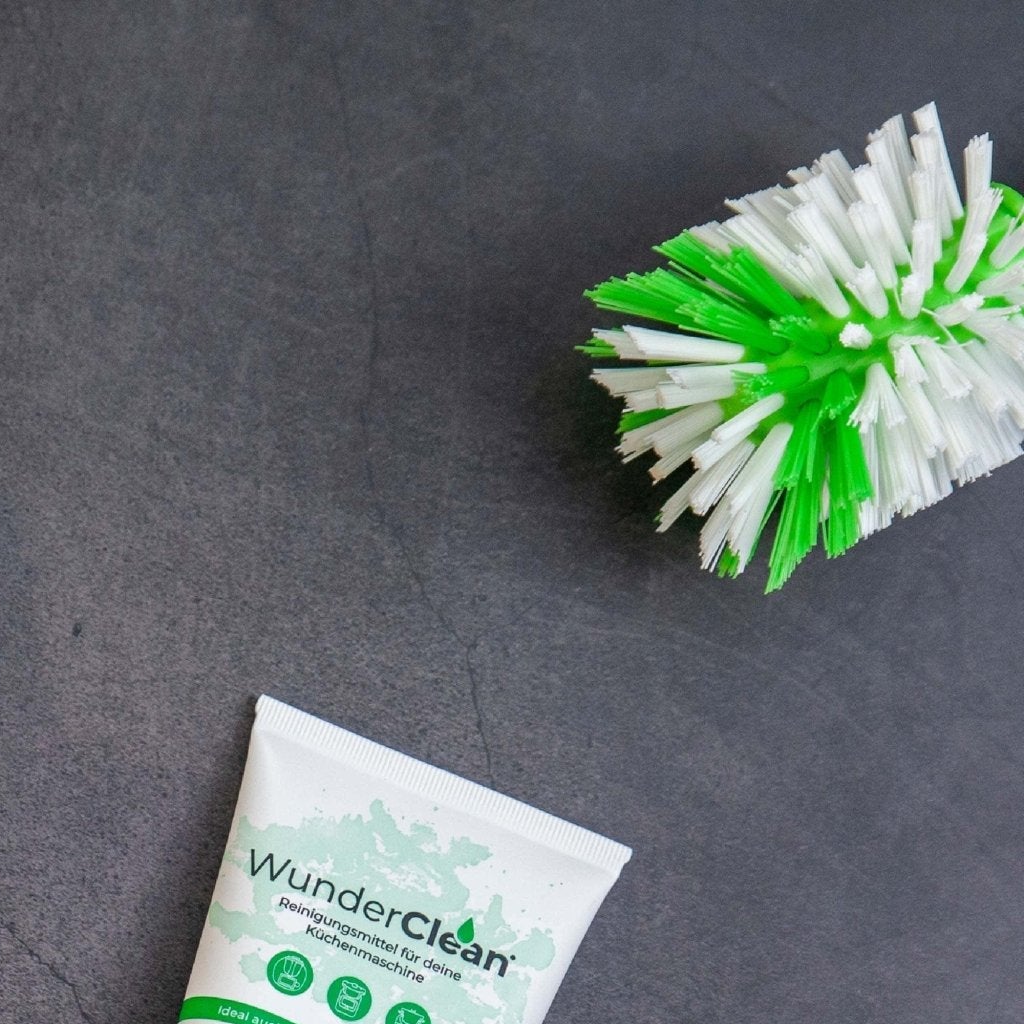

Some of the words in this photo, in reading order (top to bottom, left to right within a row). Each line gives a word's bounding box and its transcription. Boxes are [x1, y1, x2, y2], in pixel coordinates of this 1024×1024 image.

[249, 848, 509, 977] WunderClean
[279, 896, 399, 955] Reinigungsmittel
[401, 946, 422, 964] für
[423, 957, 462, 982] deine
[305, 924, 425, 984] Küchenmaschine
[218, 1004, 250, 1021] Ideal
